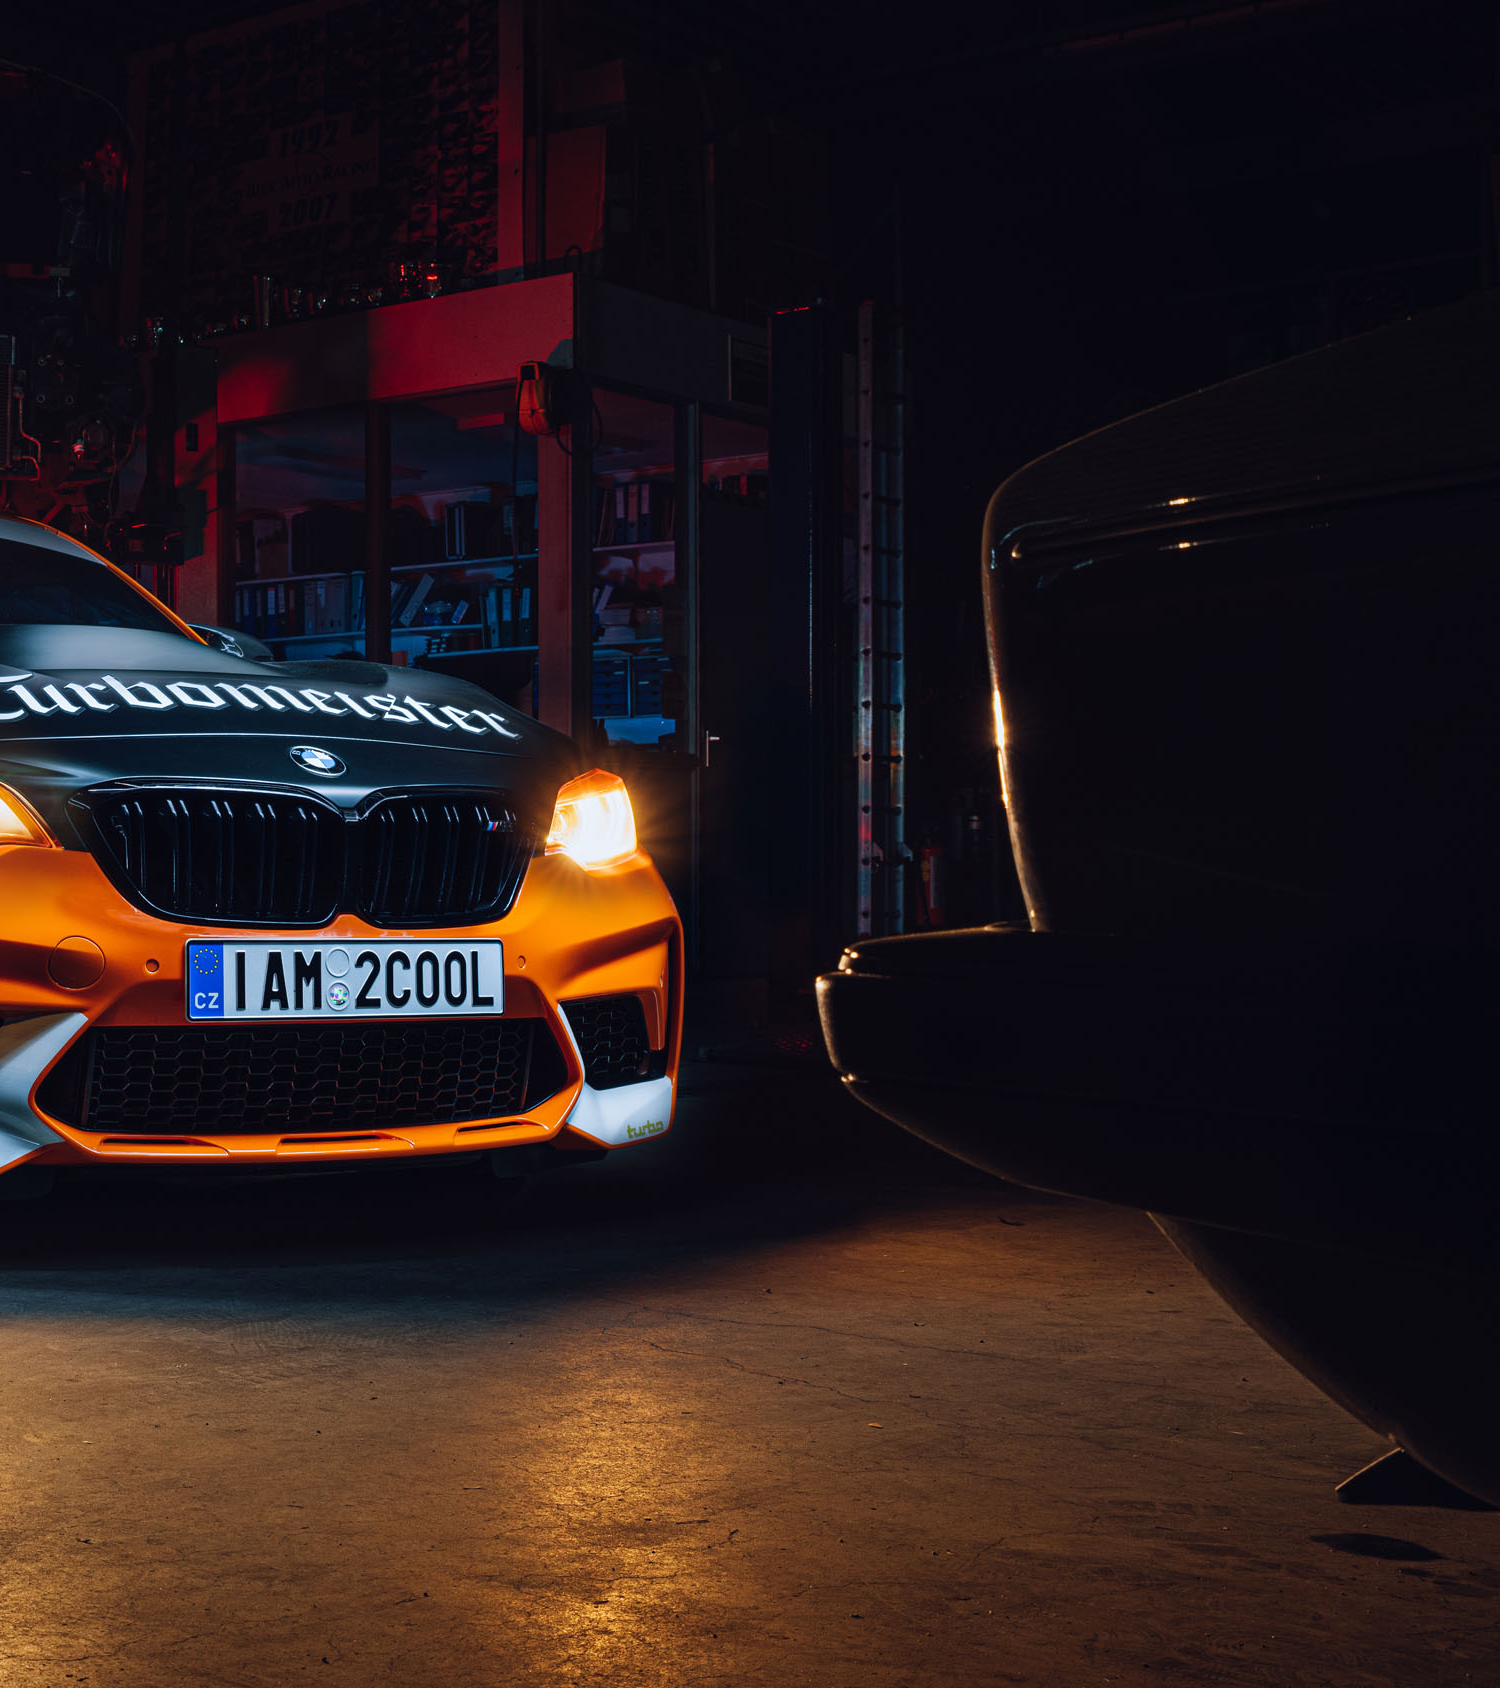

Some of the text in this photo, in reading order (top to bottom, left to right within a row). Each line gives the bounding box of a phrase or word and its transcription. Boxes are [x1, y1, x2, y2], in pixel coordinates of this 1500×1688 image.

[280, 120, 338, 157] 1992
[279, 193, 338, 226] 2007
[194, 992, 219, 1009] CZ
[626, 1120, 664, 1139] turbo
